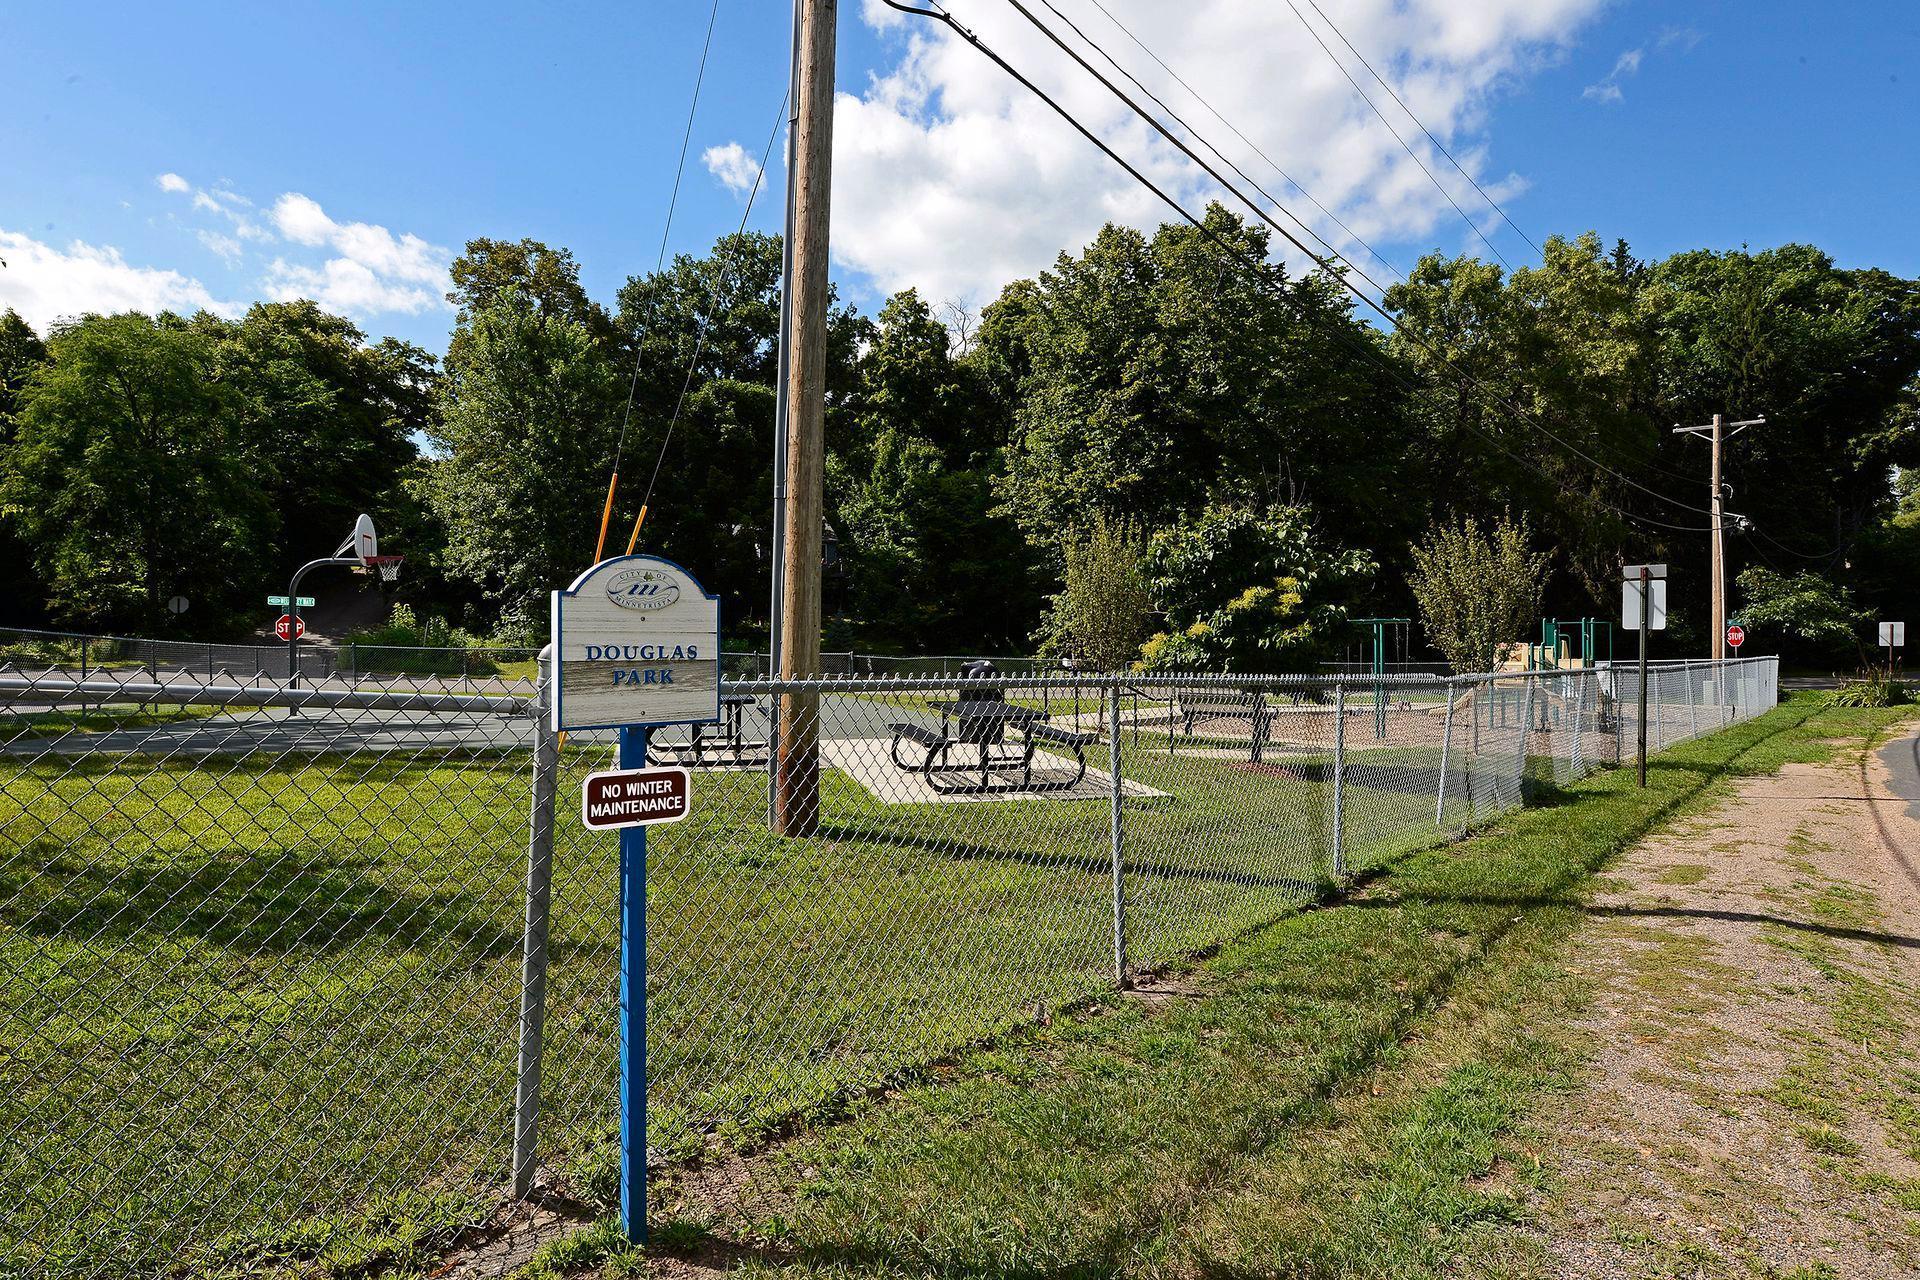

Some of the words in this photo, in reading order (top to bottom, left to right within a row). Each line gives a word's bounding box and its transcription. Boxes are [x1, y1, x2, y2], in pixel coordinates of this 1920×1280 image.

[620, 571, 641, 580] CITY
[616, 596, 672, 608] MINNETRISTA
[278, 623, 302, 633] STP
[1728, 632, 1743, 640] STOP
[585, 645, 698, 660] DOUGLAS
[612, 669, 674, 686] PARK
[602, 784, 621, 798] NO
[626, 780, 673, 796] WINTER
[590, 796, 682, 817] MAINTENANCE
